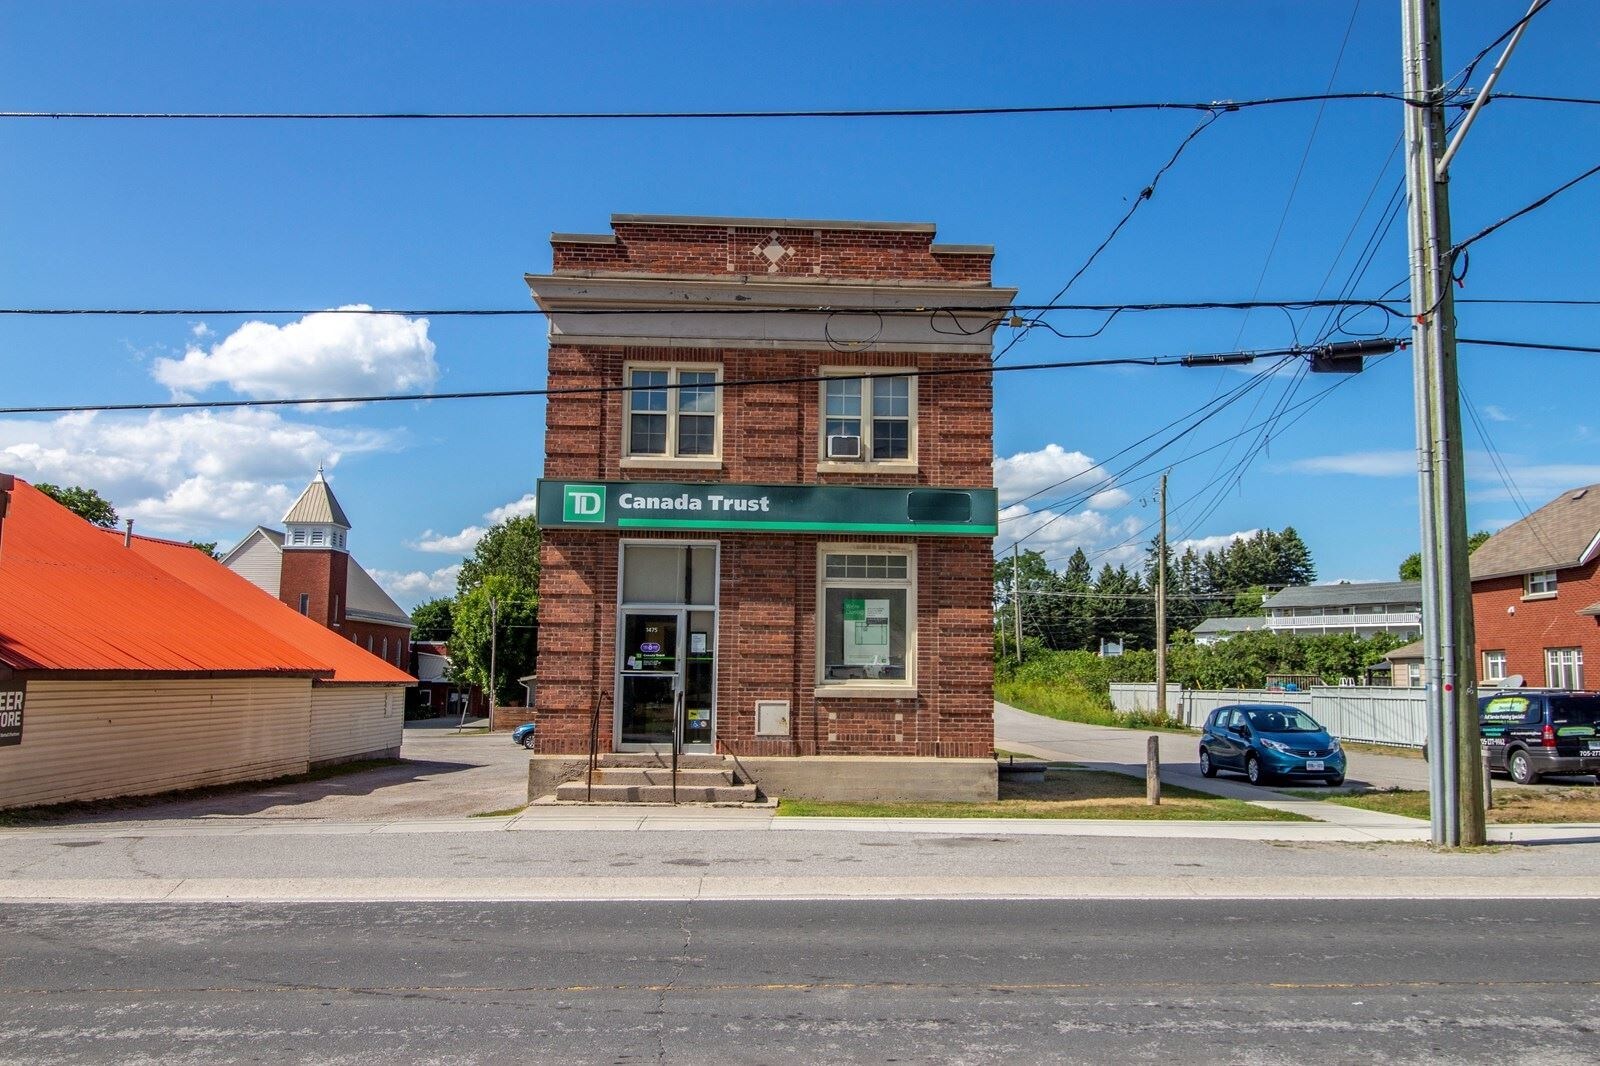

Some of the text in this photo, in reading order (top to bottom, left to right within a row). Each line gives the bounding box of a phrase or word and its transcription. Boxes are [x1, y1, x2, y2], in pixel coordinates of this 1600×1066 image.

[568, 492, 770, 514] TD Canada Trust
[0, 711, 21, 727] ORE
